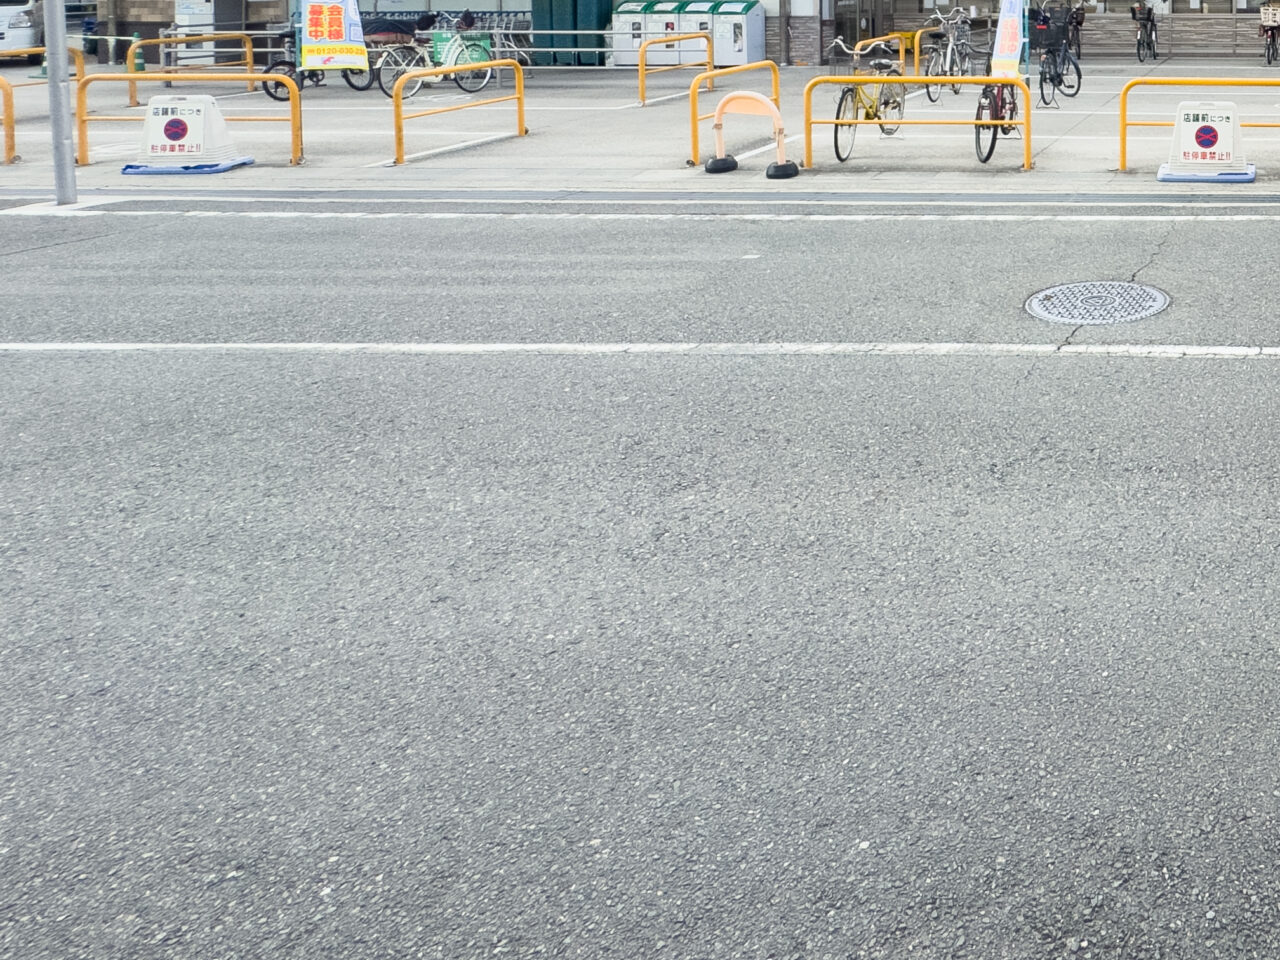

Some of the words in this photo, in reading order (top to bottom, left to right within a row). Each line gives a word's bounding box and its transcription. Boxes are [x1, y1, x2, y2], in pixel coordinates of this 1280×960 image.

[152, 107, 202, 117] 店舗前につき
[1183, 113, 1231, 123] 店舗前につき
